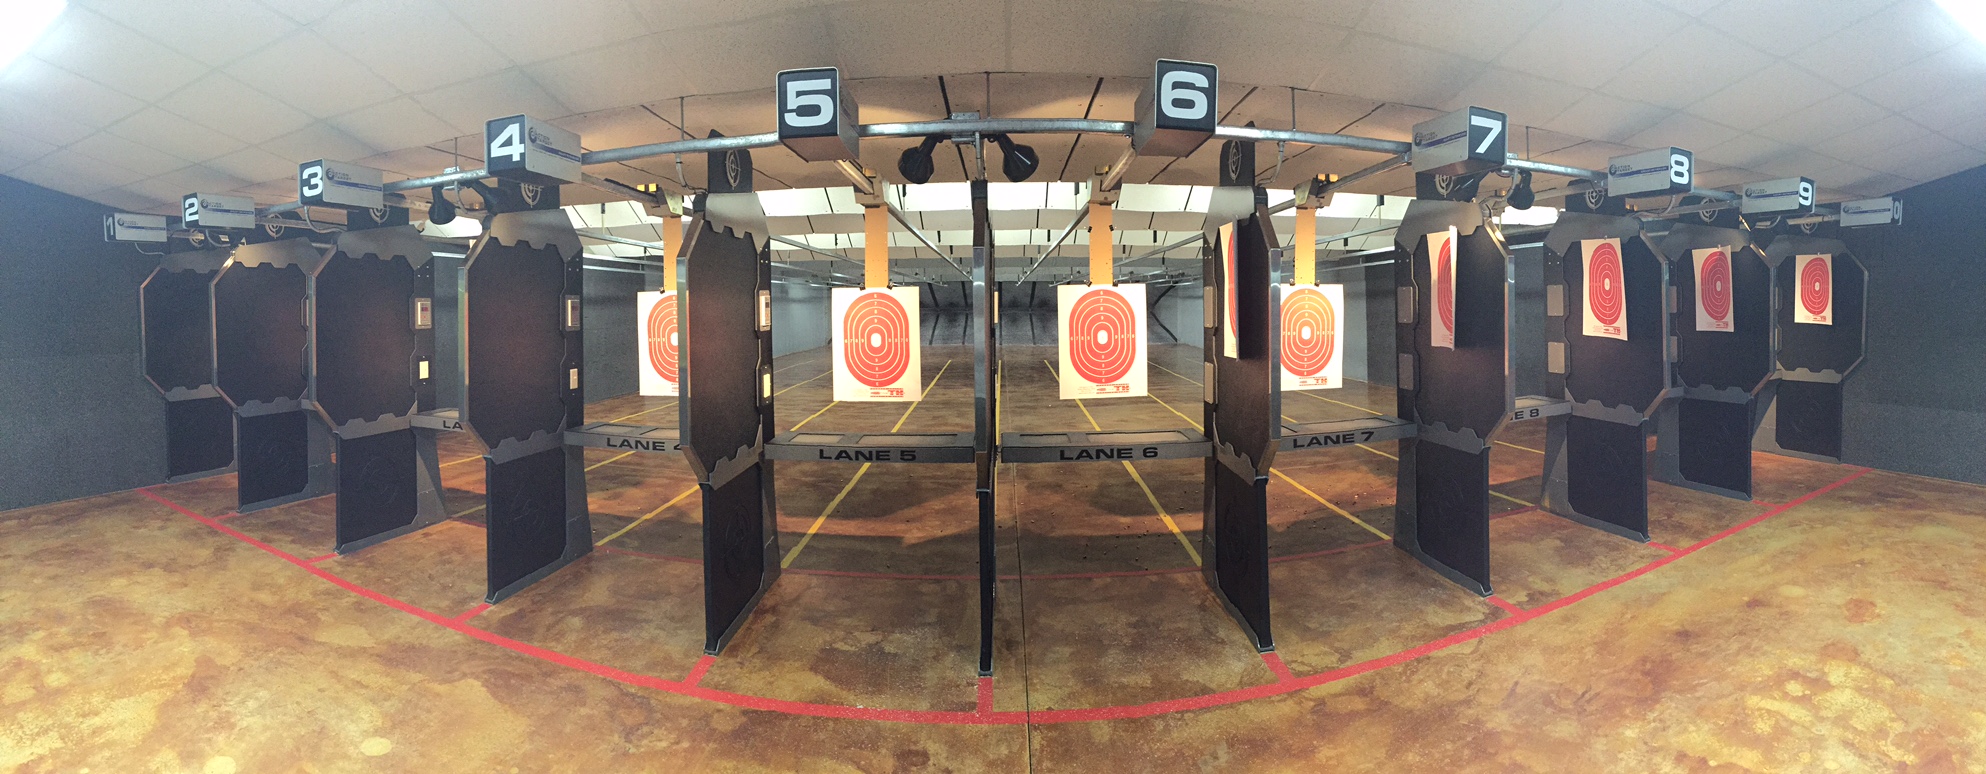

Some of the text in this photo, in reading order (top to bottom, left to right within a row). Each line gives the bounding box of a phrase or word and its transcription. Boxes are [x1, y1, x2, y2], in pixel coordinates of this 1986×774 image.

[784, 79, 834, 127] 5
[1161, 71, 1209, 119] 6
[491, 123, 524, 161] 4
[1471, 115, 1502, 153] 7
[302, 165, 323, 197] 3
[1671, 154, 1689, 184] 8
[1799, 182, 1812, 206] 9
[185, 197, 199, 222] 2
[107, 217, 113, 235] 1
[1530, 409, 1539, 417] 8
[607, 437, 665, 451] LANE
[1293, 431, 1374, 448] LANE 7
[819, 449, 916, 461] LANE 5
[1060, 447, 1158, 460] LANE 6
